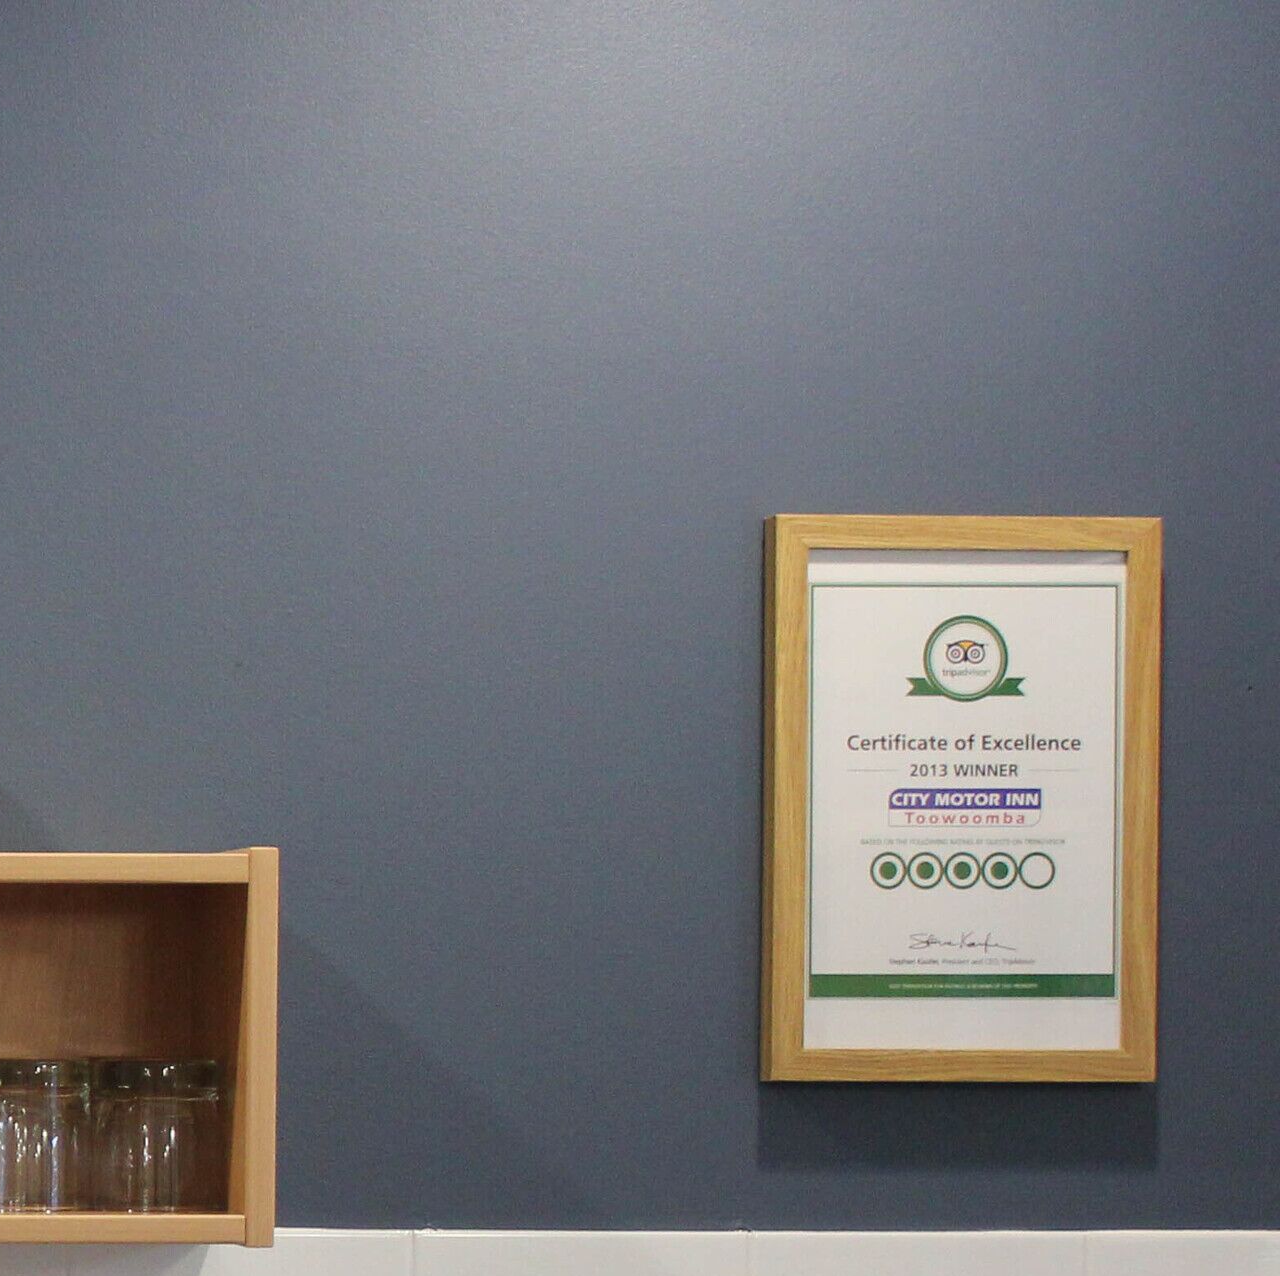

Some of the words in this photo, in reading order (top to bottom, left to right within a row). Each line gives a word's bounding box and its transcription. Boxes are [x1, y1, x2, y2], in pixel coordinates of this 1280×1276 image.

[847, 733, 948, 752] Certificate
[954, 733, 976, 752] of
[981, 733, 1082, 752] Excellence
[910, 764, 948, 778] 2013
[954, 764, 1019, 778] WINNER
[891, 793, 929, 807] CITY
[934, 793, 1000, 807] MOTOR
[1006, 793, 1039, 807] INN
[904, 812, 1025, 825] Toowoomba
